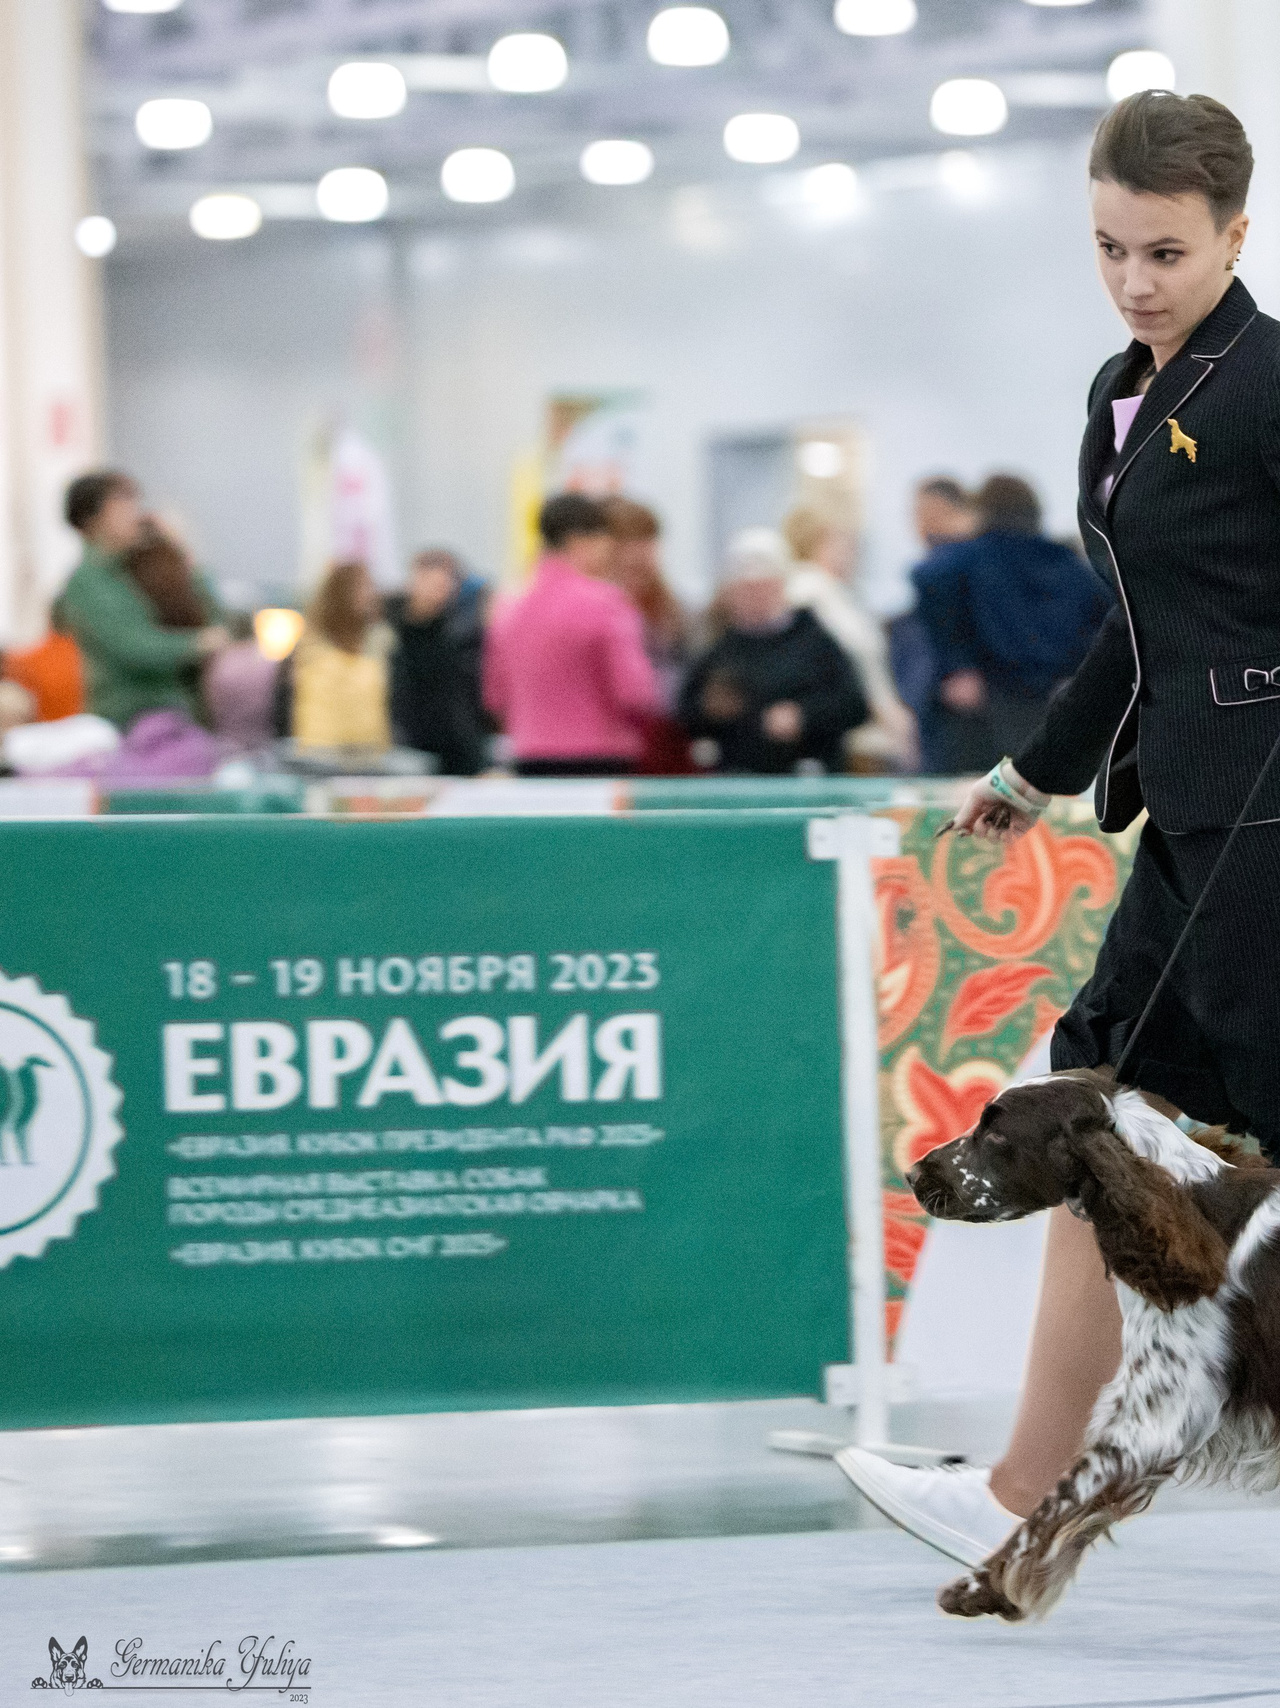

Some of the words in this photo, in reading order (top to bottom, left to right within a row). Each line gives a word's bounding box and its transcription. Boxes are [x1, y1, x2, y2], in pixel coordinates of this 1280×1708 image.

[161, 959, 218, 999] 18
[270, 956, 322, 997] 19
[338, 953, 537, 994] НОЯБРЯ
[549, 951, 660, 990] 2023
[162, 1012, 662, 1113] ЕВРАЗИЯ
